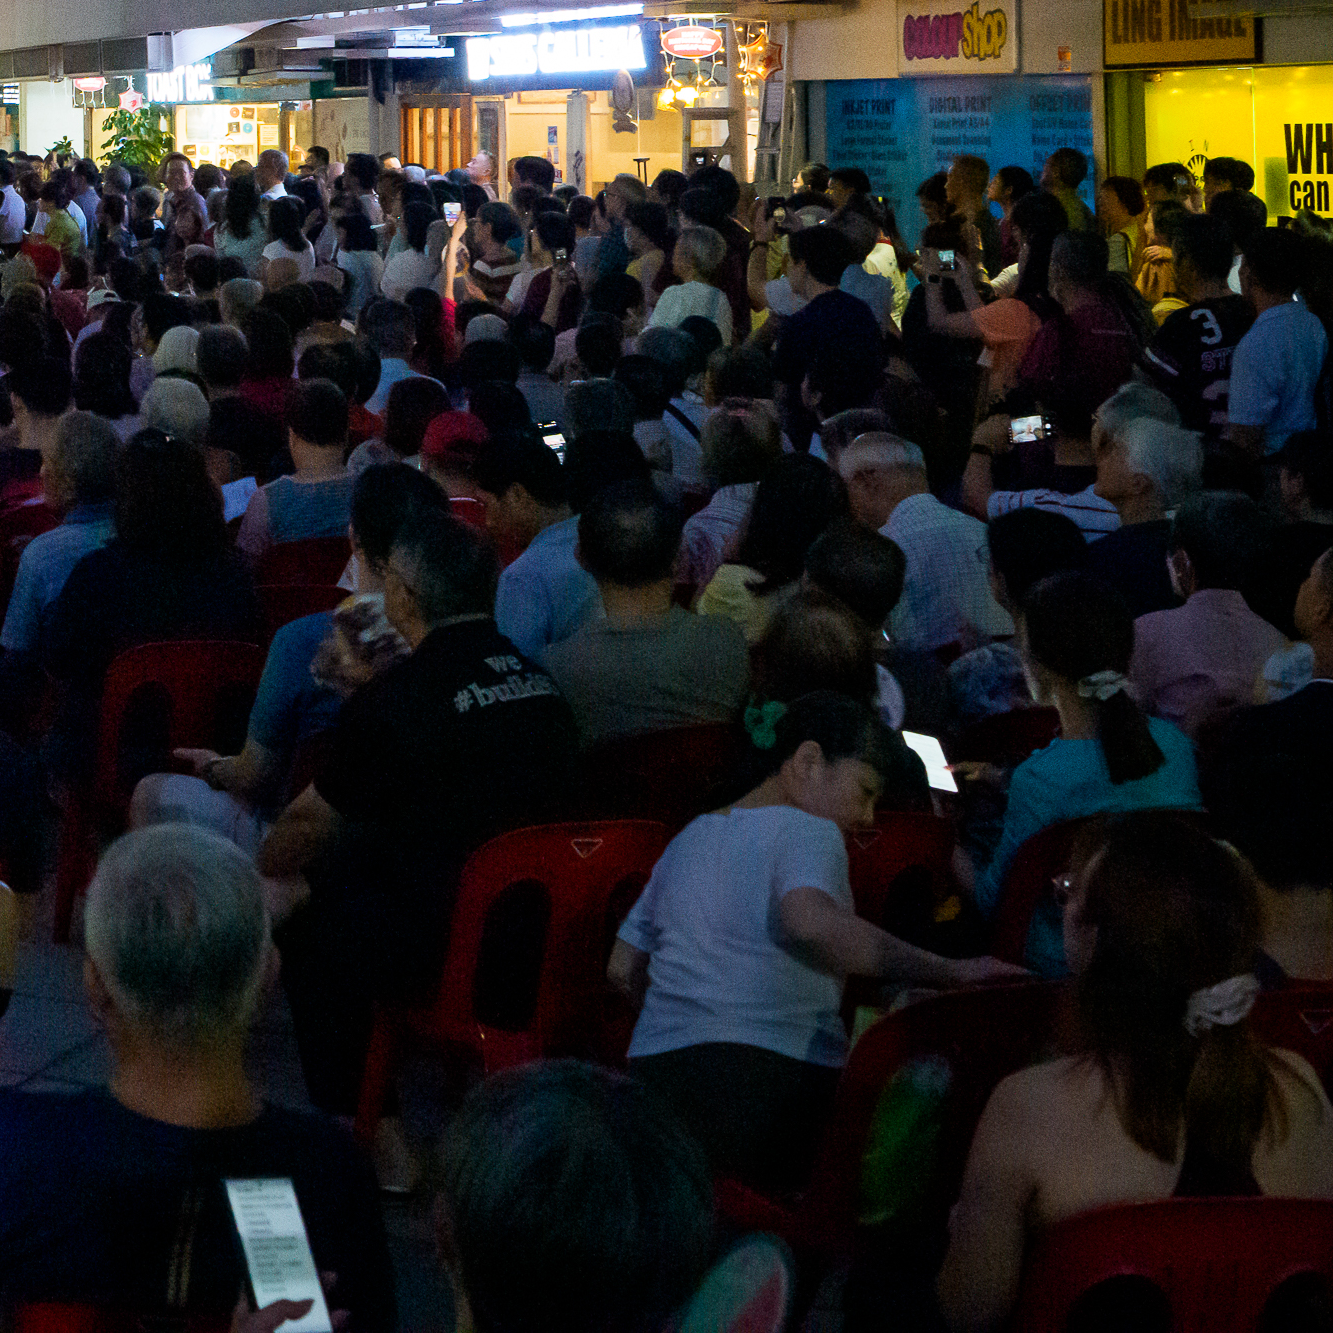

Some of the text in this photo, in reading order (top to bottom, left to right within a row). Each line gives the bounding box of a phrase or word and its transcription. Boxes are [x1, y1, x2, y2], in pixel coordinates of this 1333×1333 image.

[145, 66, 184, 103] TOAST
[871, 98, 896, 115] PRINT
[929, 95, 992, 113] DIGITAL PRINT
[1289, 180, 1330, 212] can
[1189, 307, 1224, 346] 3
[483, 654, 523, 674] we
